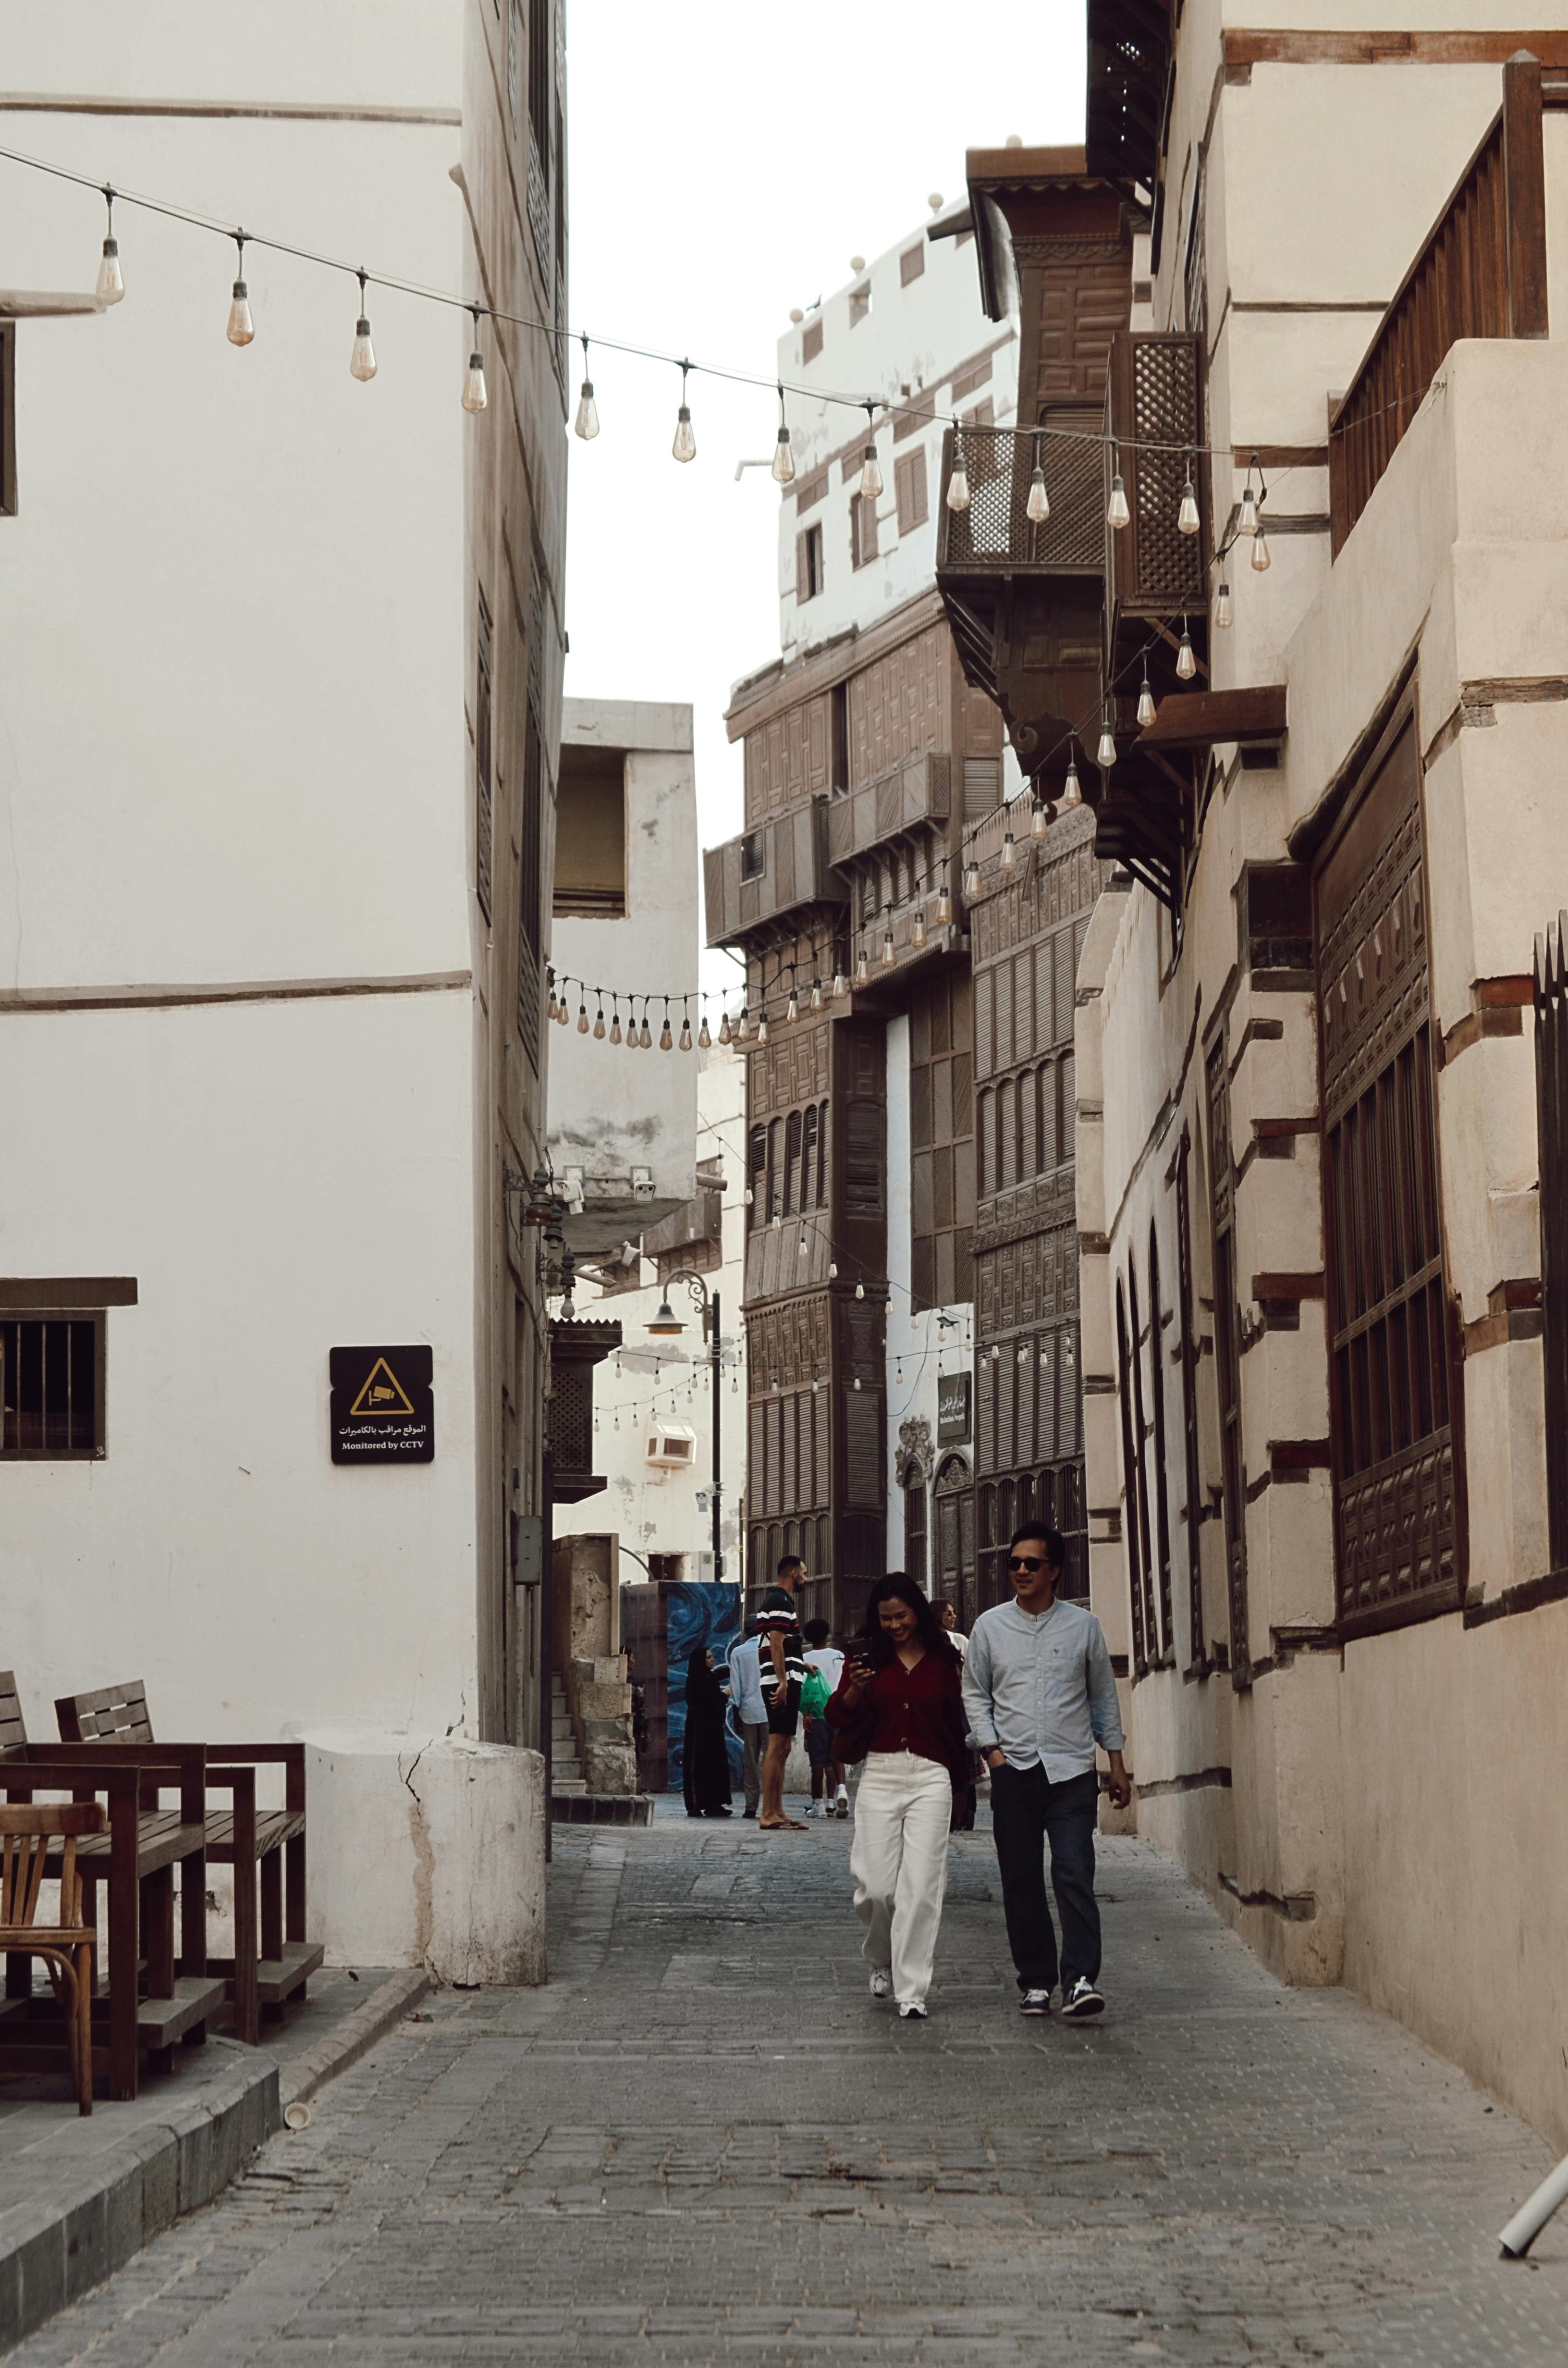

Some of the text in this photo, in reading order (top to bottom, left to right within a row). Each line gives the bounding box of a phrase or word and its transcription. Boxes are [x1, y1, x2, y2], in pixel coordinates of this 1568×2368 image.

[339, 1425, 426, 1437] الموقع مراقب بالكاميرات
[342, 1442, 386, 1450] Monitored
[388, 1442, 398, 1450] by
